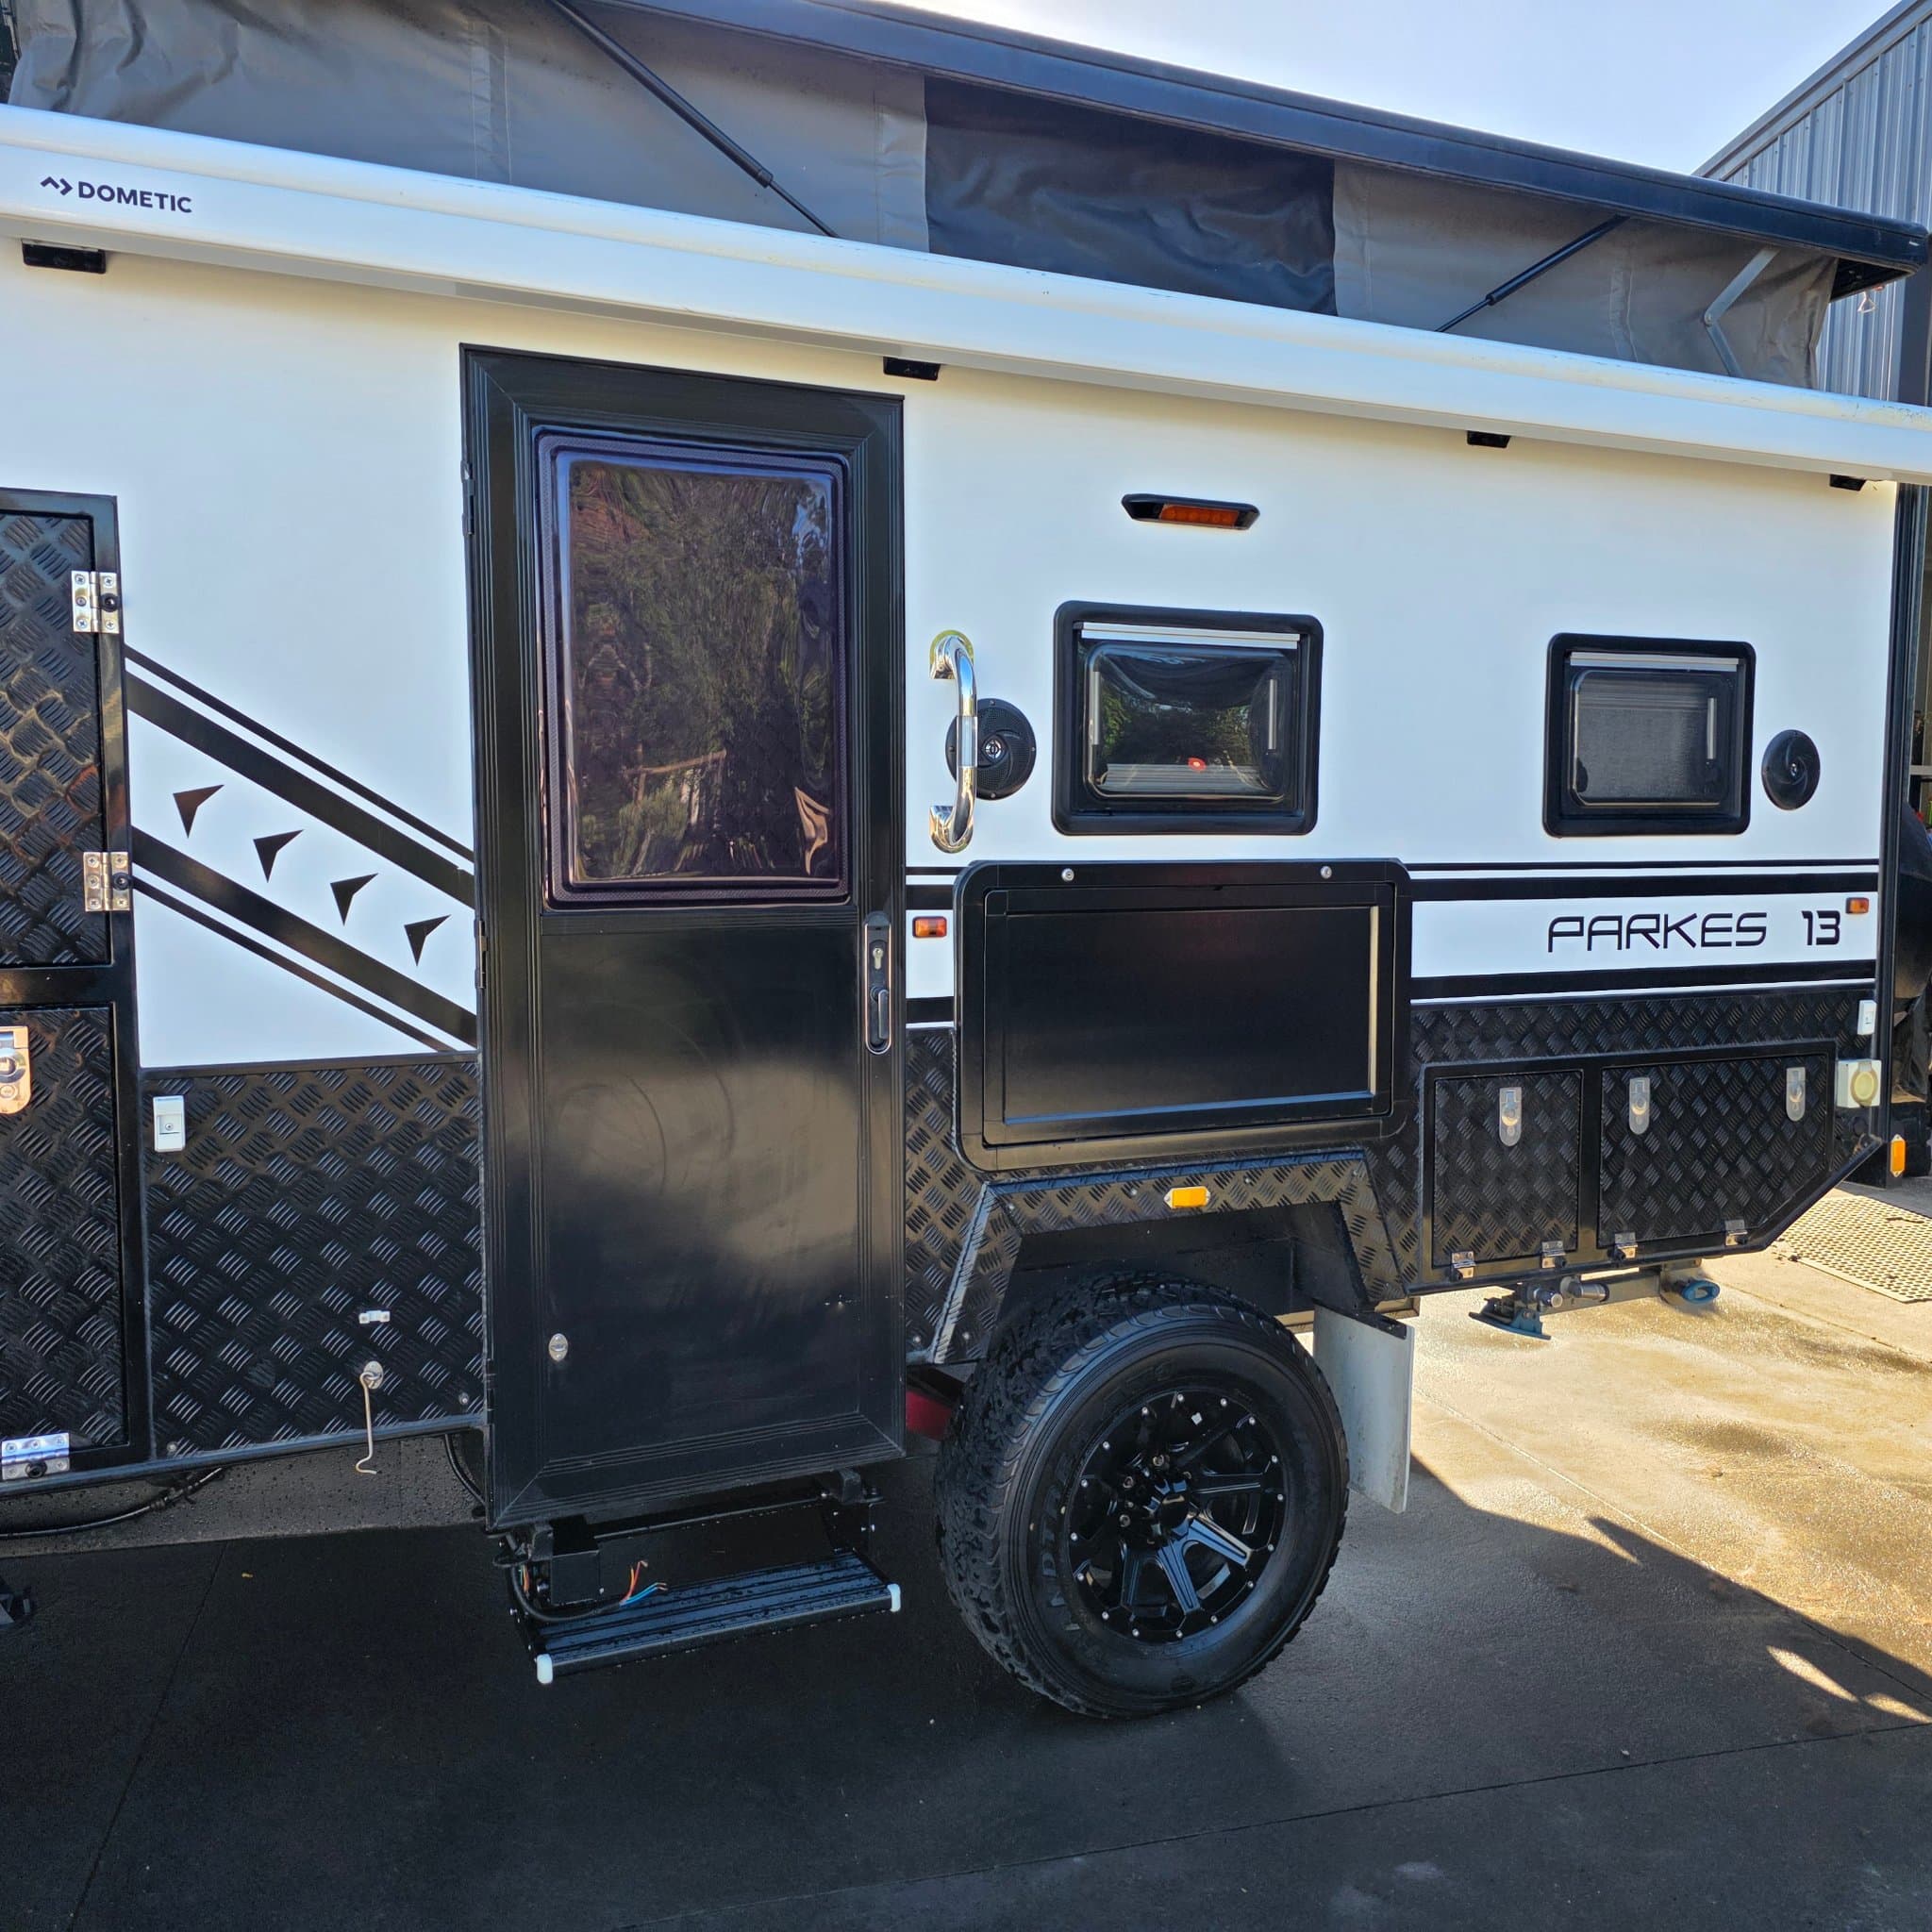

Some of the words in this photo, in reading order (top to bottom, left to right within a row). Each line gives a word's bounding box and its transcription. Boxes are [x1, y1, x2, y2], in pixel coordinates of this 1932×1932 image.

[78, 181, 192, 213] DOMETIC
[1548, 912, 1767, 953] PARKES
[1802, 910, 1840, 946] 13
